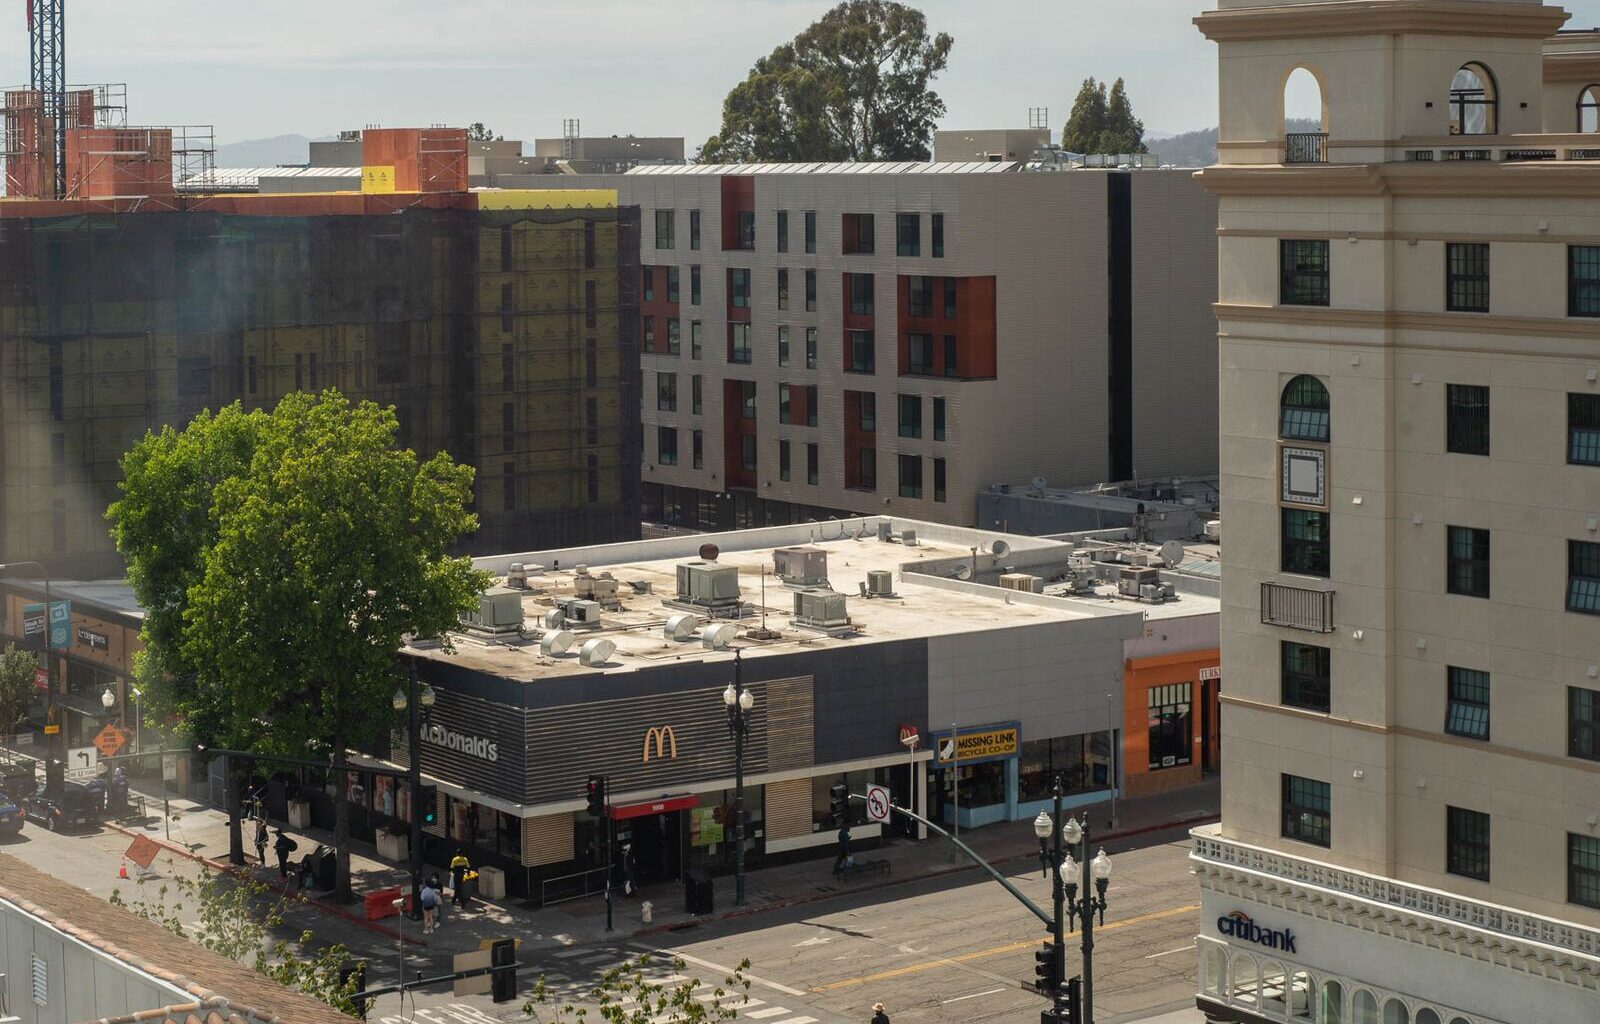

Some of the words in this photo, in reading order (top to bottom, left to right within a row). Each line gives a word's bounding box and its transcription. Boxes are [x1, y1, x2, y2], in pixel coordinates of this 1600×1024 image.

[957, 735, 993, 749] MISSING
[995, 731, 1015, 744] LINK
[957, 748, 986, 758] BICYCLE
[1217, 913, 1296, 954] citibank
